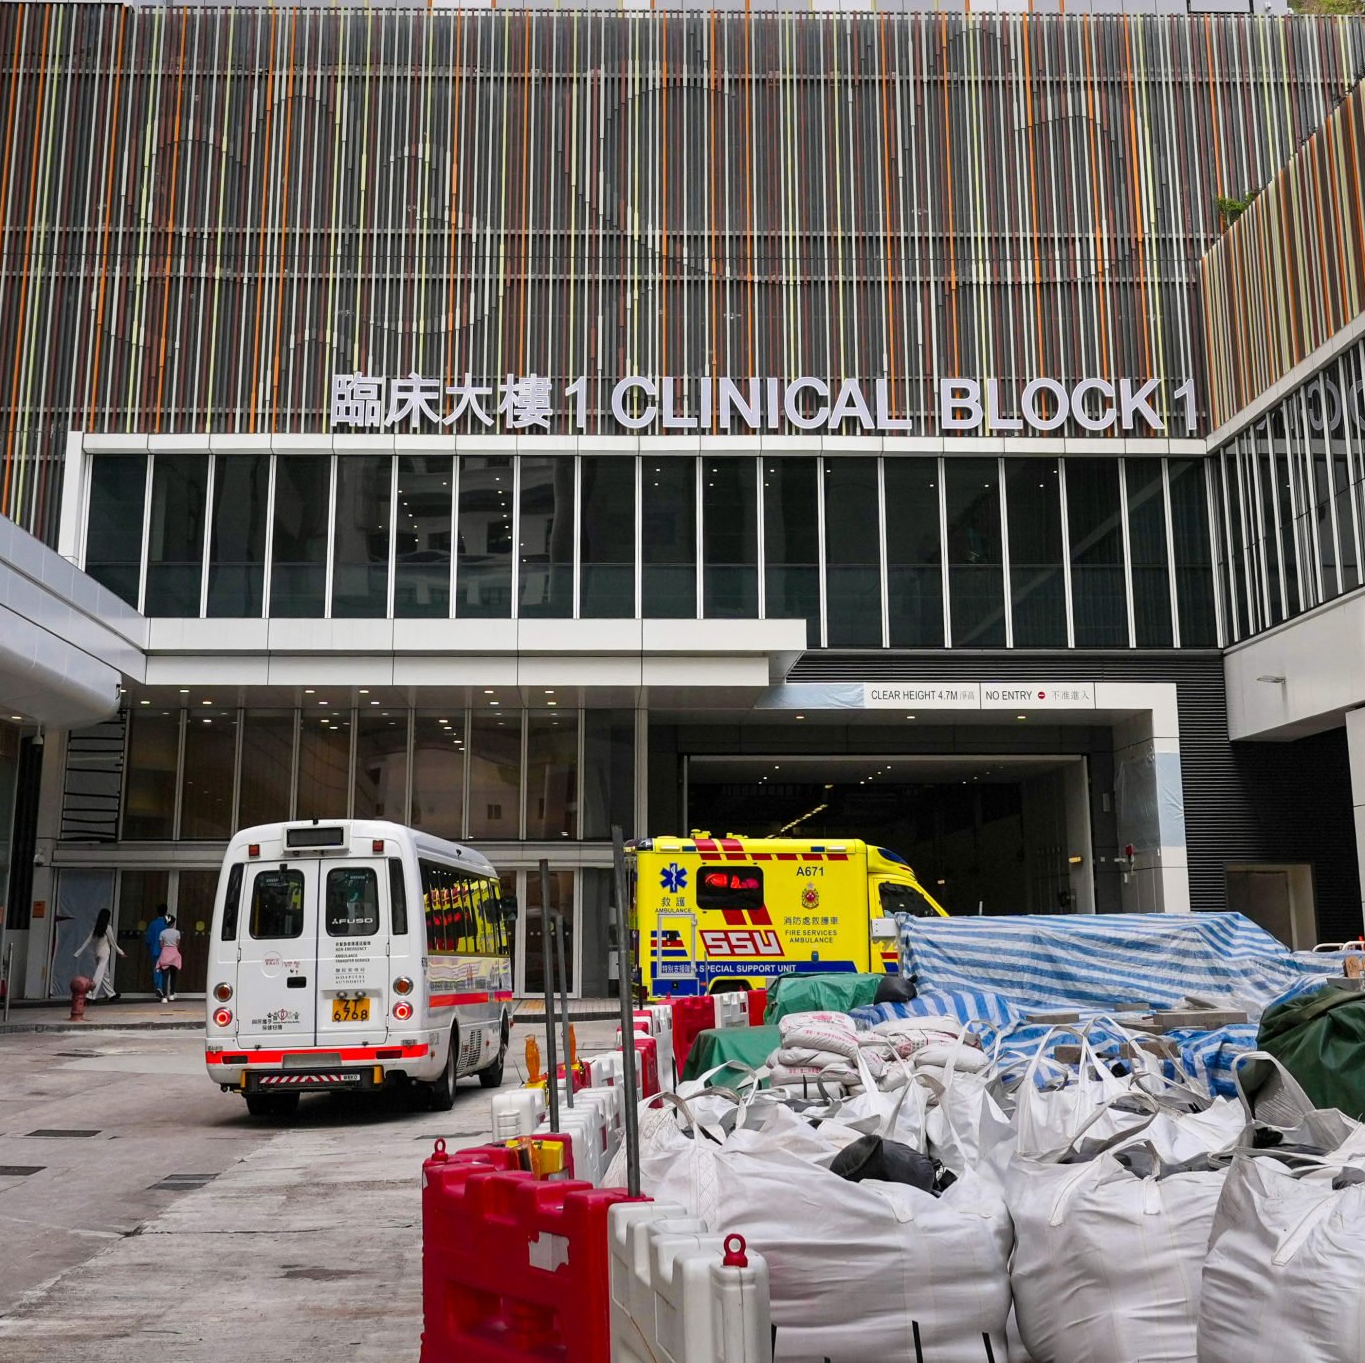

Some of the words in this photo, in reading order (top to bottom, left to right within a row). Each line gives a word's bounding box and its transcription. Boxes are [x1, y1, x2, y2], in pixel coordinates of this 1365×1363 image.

[331, 372, 553, 428] 臨床大樓
[564, 376, 586, 428] 1
[611, 376, 913, 430] CLINICAL
[941, 377, 1166, 431] BLOCK
[1173, 378, 1197, 431] 1
[871, 690, 901, 700] CLEAR
[903, 690, 936, 700] HEIGHT
[938, 690, 958, 700] 4.7M
[985, 691, 1000, 700] NO
[1002, 690, 1033, 700] ENTRY
[796, 866, 824, 876] A671
[661, 897, 685, 907] 救護
[702, 931, 782, 955] SSU
[699, 965, 734, 973] SPECIAL
[736, 965, 775, 973] SUPPORT
[778, 964, 797, 972] UNIT
[334, 1010, 369, 1022] 6768
